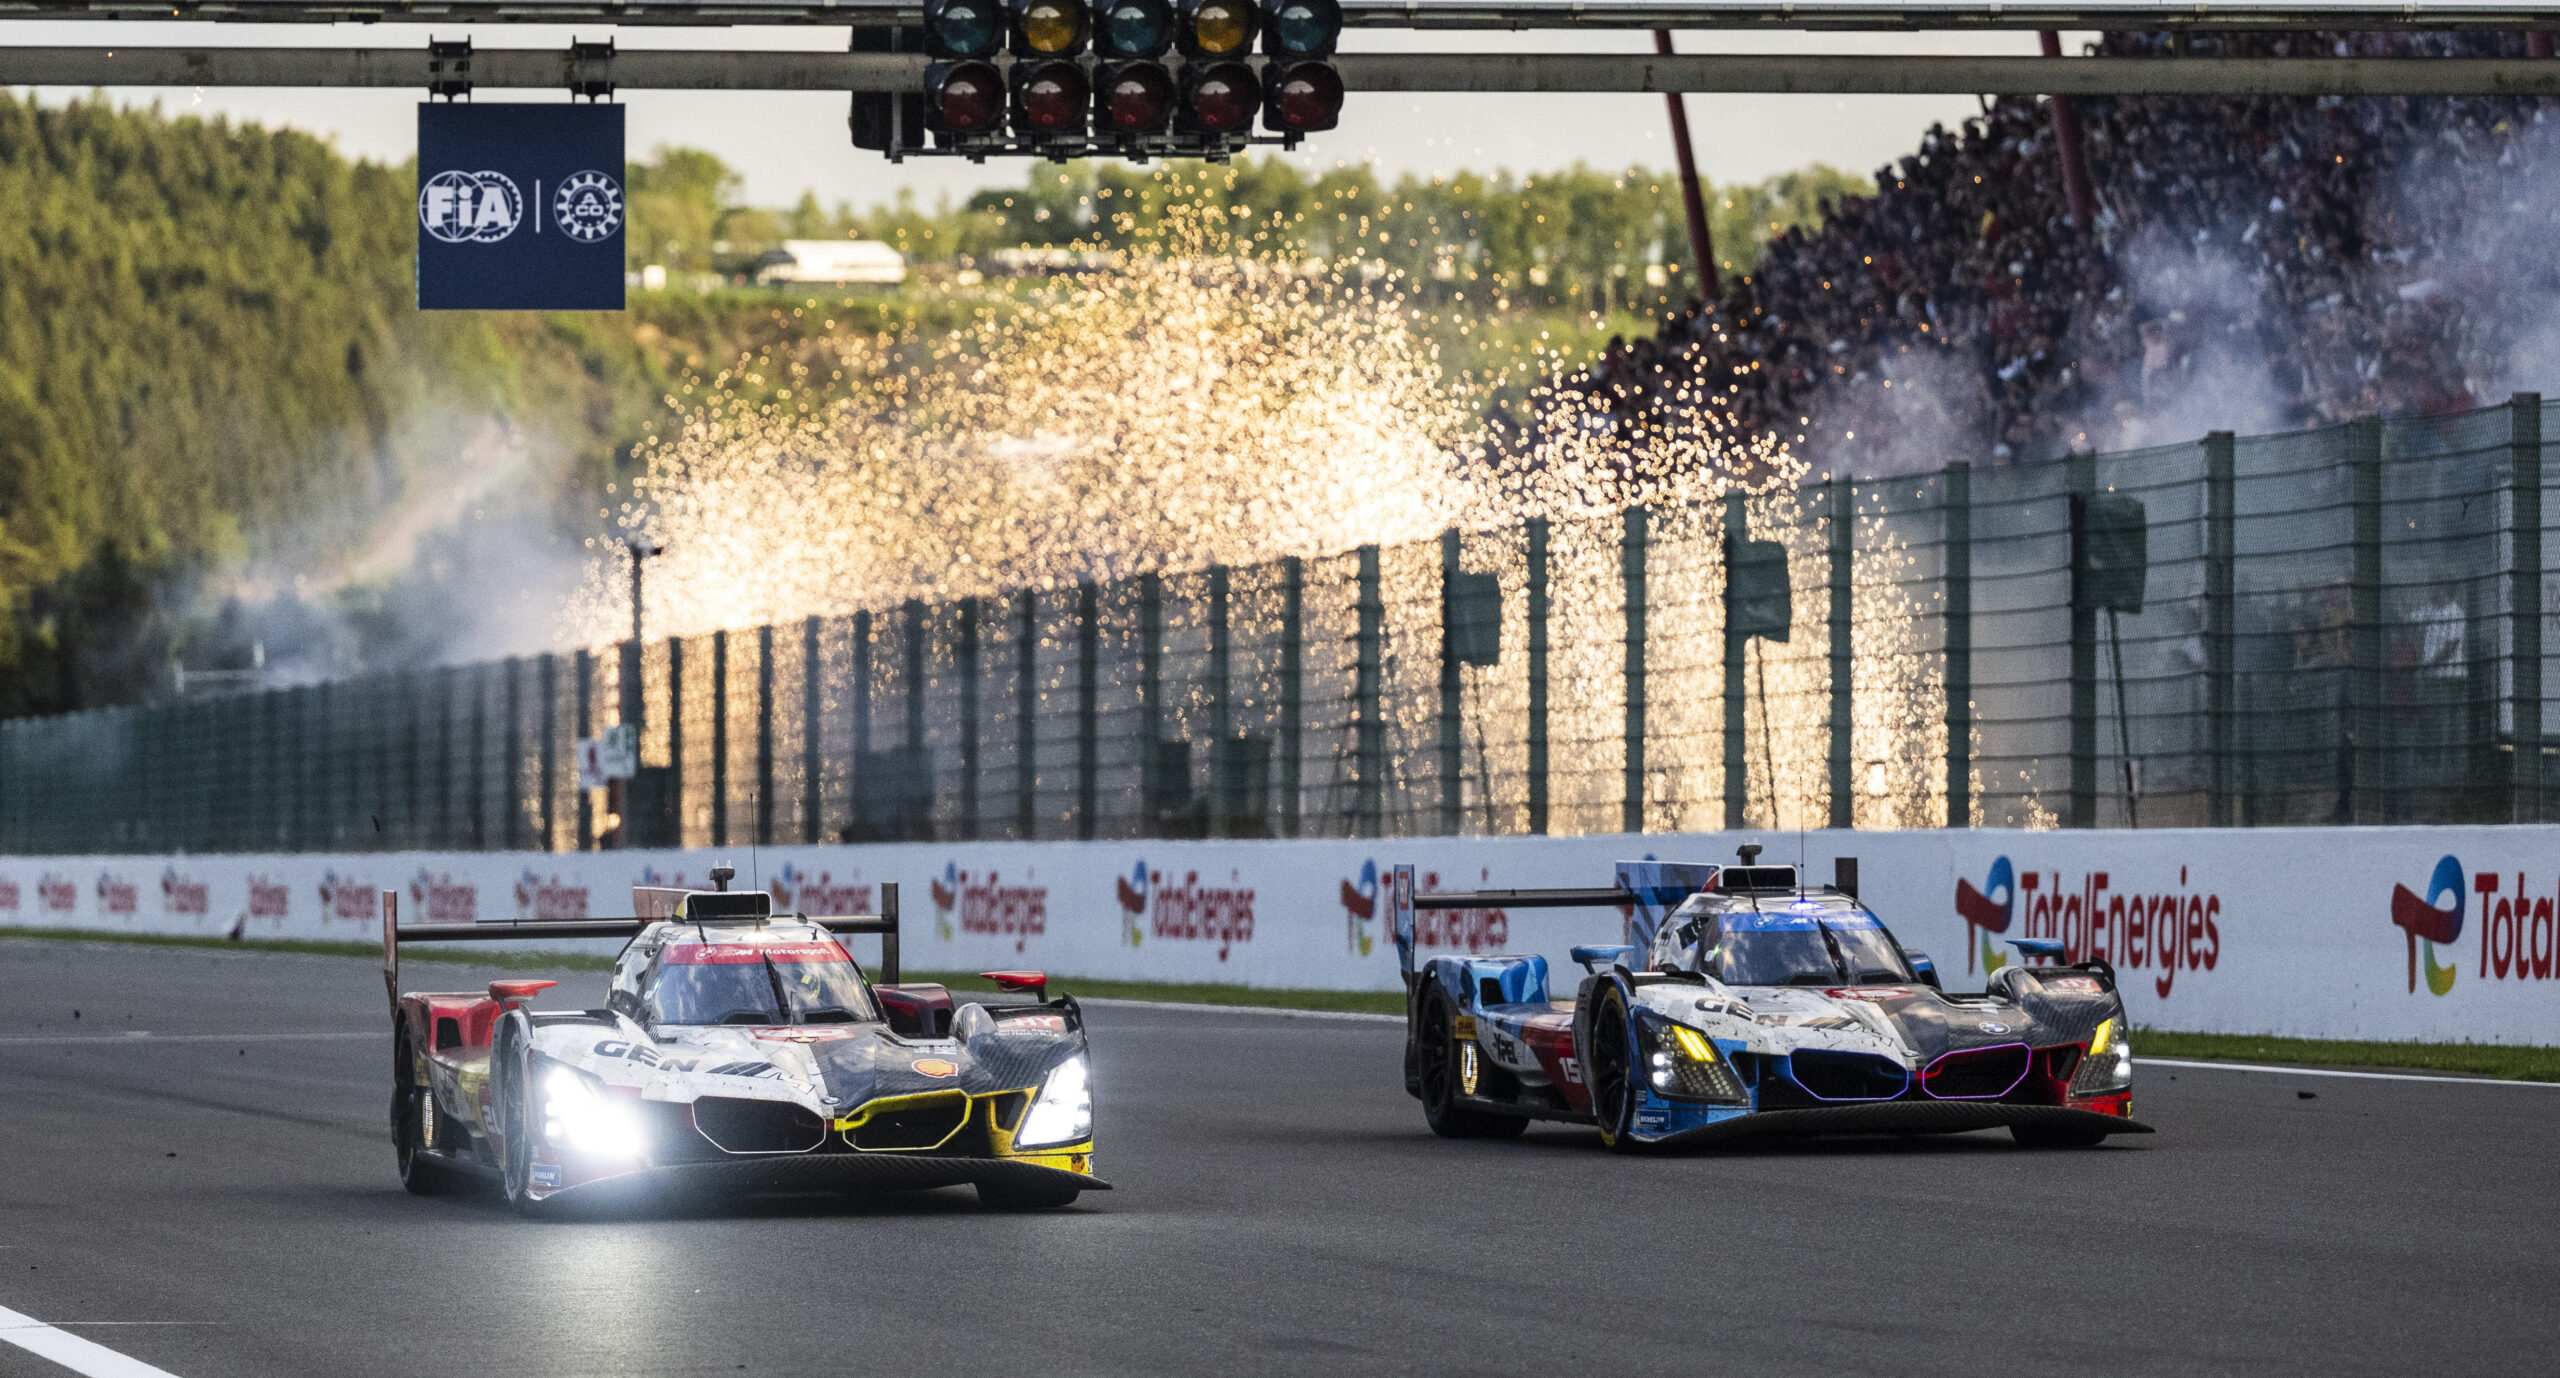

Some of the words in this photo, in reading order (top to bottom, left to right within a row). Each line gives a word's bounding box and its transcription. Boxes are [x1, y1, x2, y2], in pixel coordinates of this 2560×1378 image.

[2020, 864, 2220, 999] TotalEnergies
[1695, 997, 1788, 1027] GEN
[593, 1040, 700, 1073] GEN
[1559, 1057, 1583, 1084] 15
